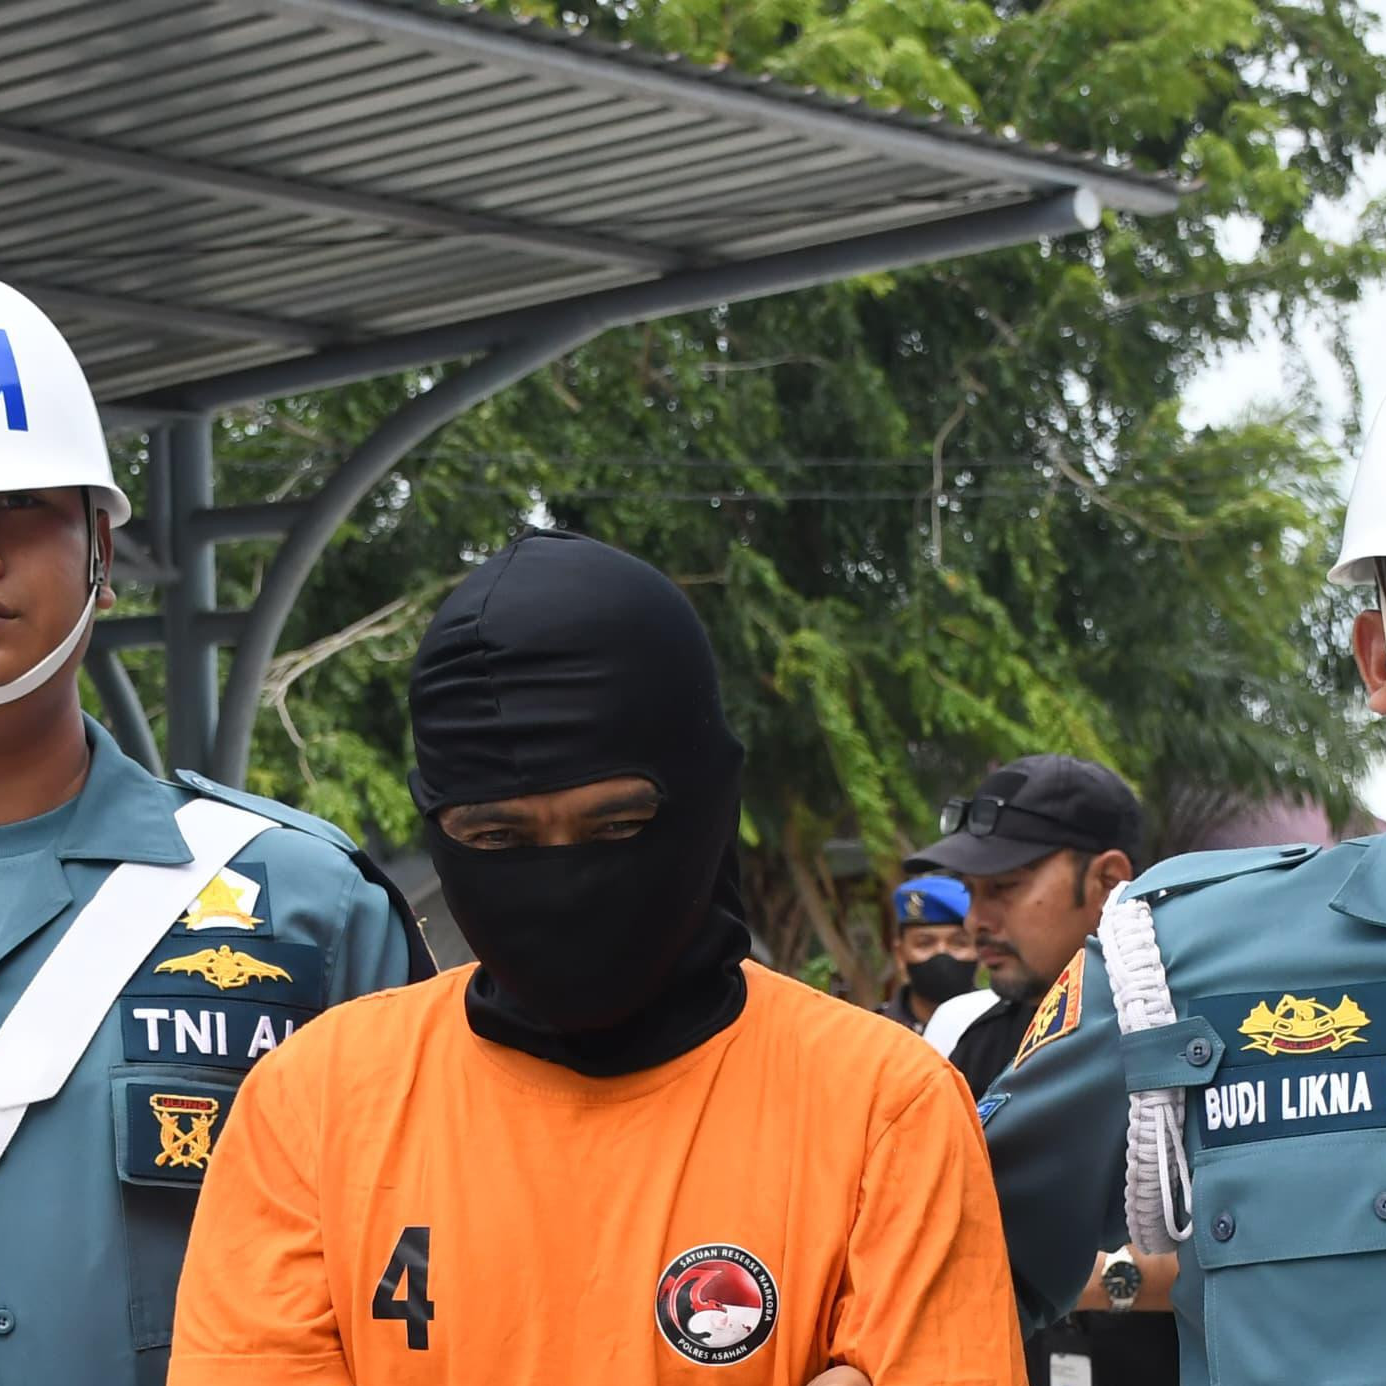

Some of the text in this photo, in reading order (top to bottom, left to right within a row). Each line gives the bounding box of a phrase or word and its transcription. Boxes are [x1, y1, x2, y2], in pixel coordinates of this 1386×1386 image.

[132, 1008, 229, 1056] TNI
[1204, 1080, 1266, 1131] BUDI
[1281, 1071, 1373, 1121] LIKNA
[372, 1226, 436, 1351] 4
[679, 1248, 774, 1321] SATUAN RESERSE NARKOBA
[677, 1338, 748, 1361] POLRES ASAHAN
